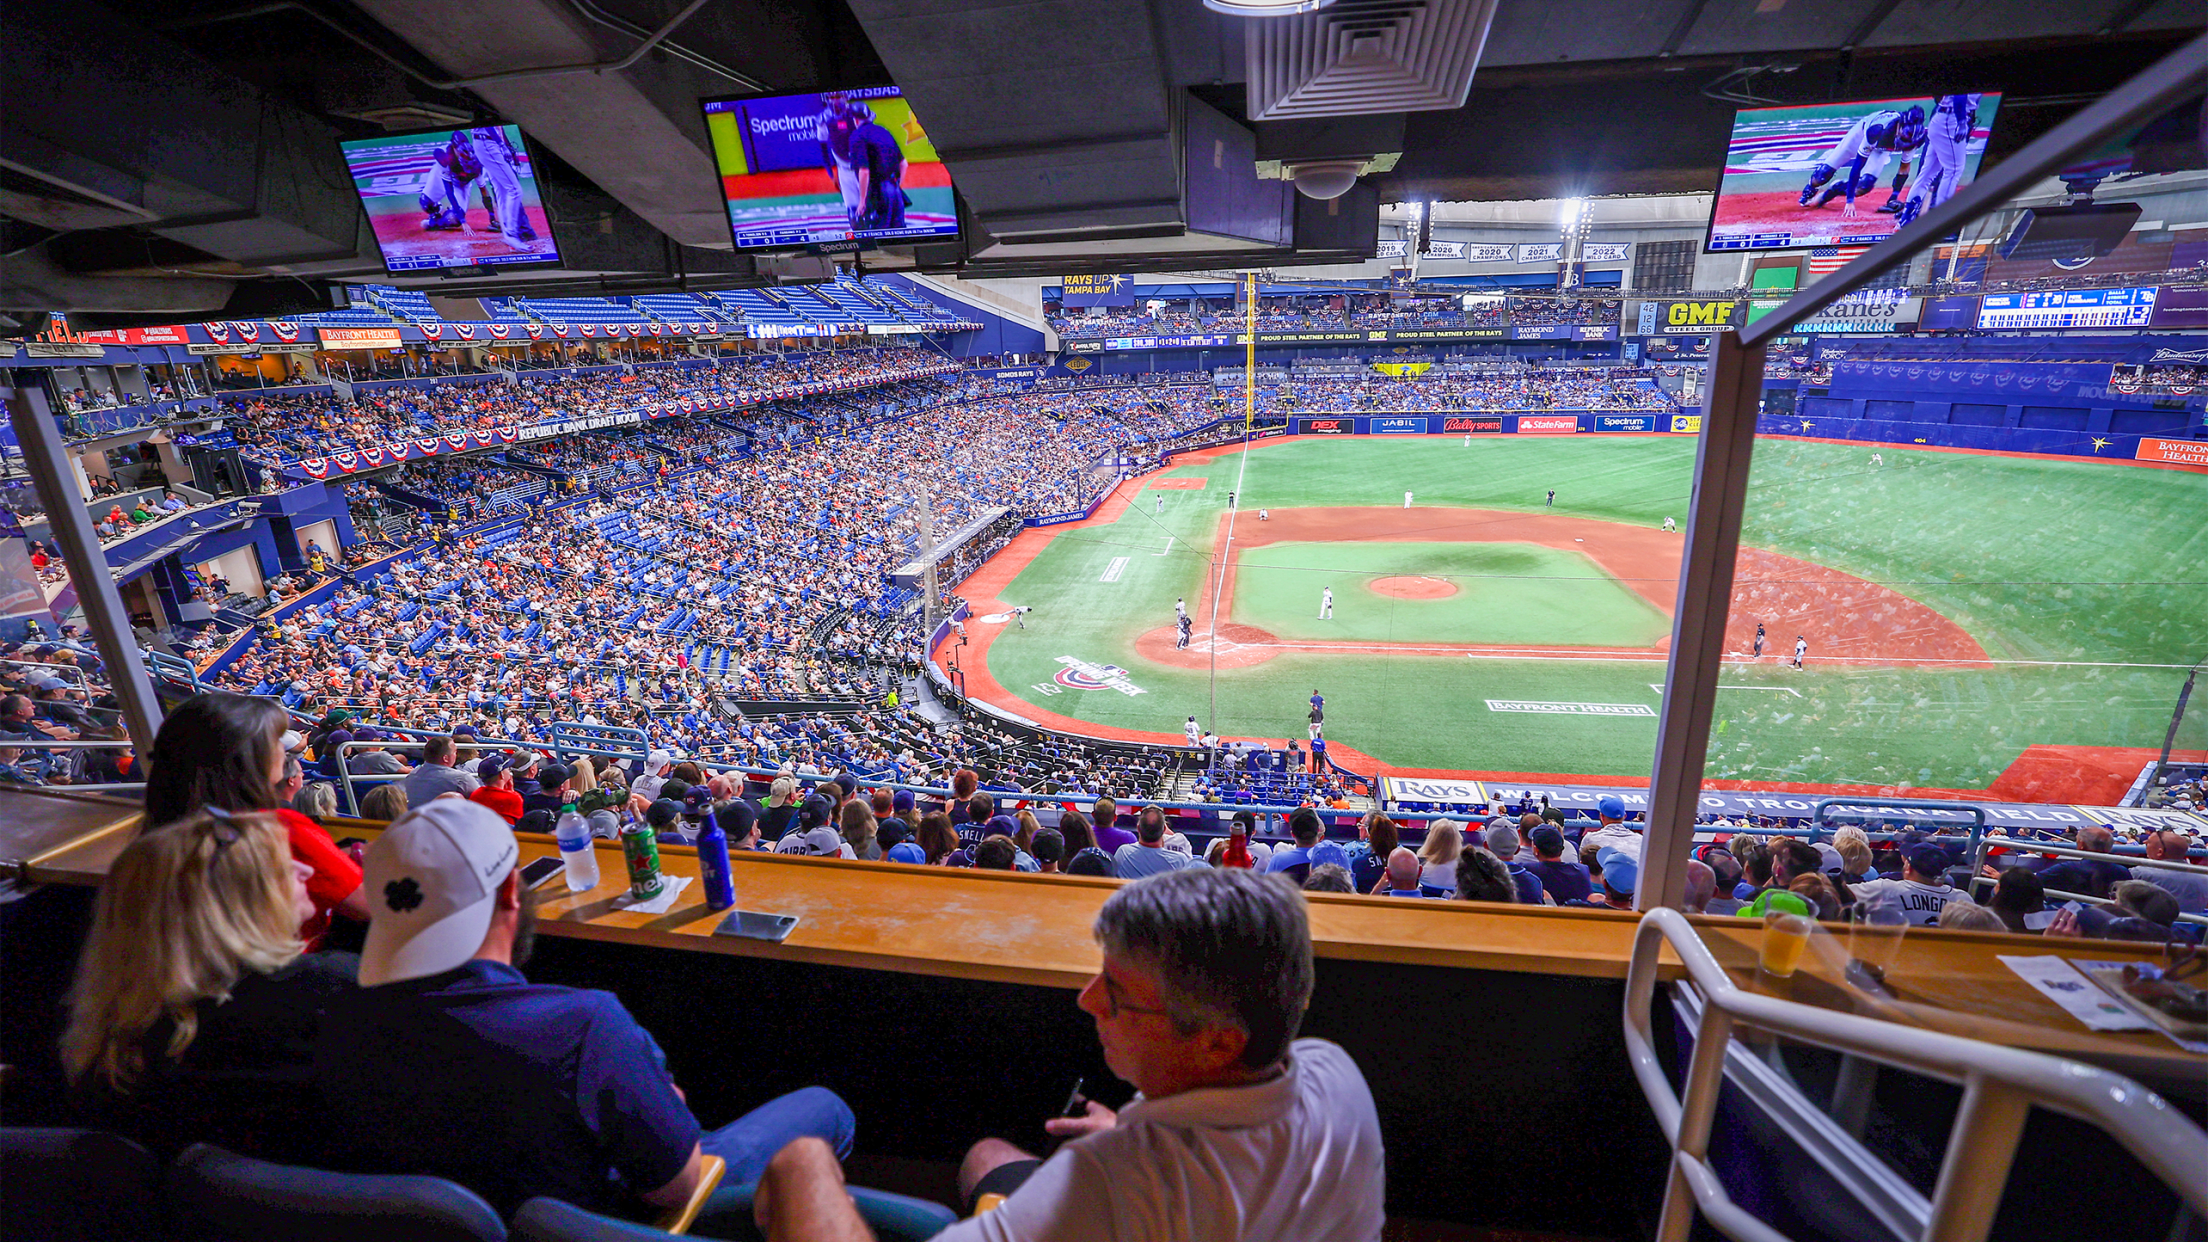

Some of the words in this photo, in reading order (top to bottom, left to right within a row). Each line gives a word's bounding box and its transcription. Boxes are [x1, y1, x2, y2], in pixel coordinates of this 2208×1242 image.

[819, 242, 859, 254] Spectrum
[1063, 275, 1093, 285] RAYS
[1094, 274, 1110, 284] UP
[1064, 286, 1093, 294] TAMPA
[1094, 285, 1111, 294] BAY
[1643, 304, 1654, 312] 42
[1668, 302, 1735, 325] GMF
[1643, 314, 1652, 323] 12
[326, 329, 366, 340] BAYFRONT
[367, 329, 396, 339] HEALTH
[1640, 325, 1651, 333] 66
[519, 422, 563, 440] REPUBLIC
[563, 420, 589, 434] BANK
[588, 415, 615, 430] DRAFT
[616, 411, 641, 425] ROOM
[1310, 421, 1340, 429] DEX
[1445, 418, 1477, 432] Bally
[1604, 417, 1643, 427] Spectrum
[1039, 515, 1067, 525] RAYMOND
[1066, 512, 1084, 521] JAMES
[1494, 702, 1577, 712] BAYFRONT
[1577, 703, 1649, 715] HEALTH
[1397, 780, 1471, 799] RAYS
[1493, 788, 1650, 805] WELCOM
[2093, 809, 2198, 830] RAYS
